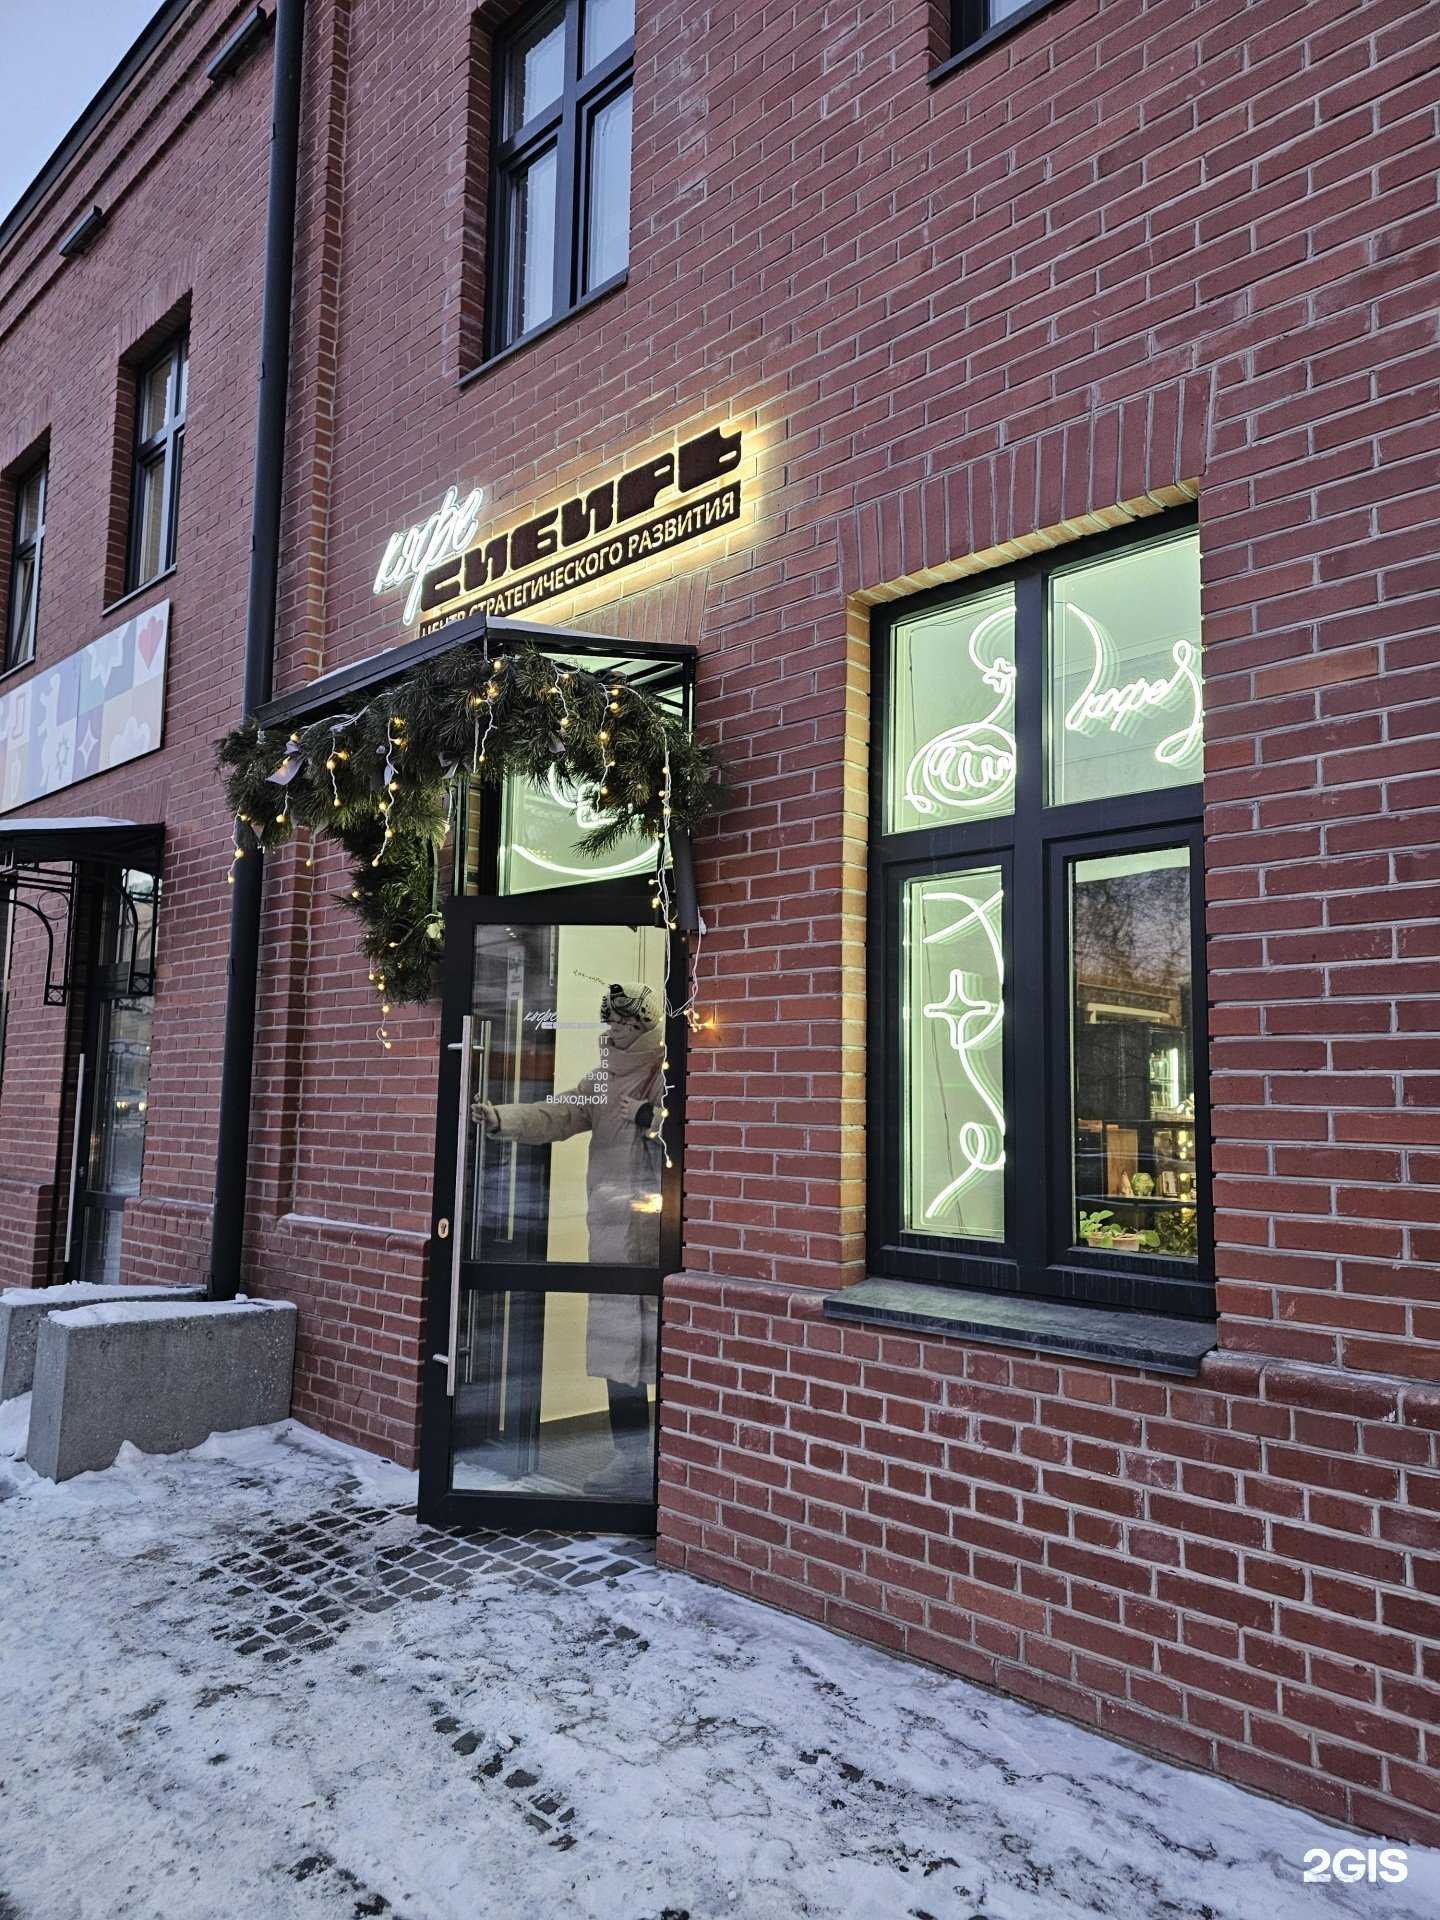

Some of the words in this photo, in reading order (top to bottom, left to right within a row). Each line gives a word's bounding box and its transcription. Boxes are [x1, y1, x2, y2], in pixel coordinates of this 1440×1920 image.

[627, 490, 735, 559] РАЗВИТИЯ
[593, 1083, 609, 1093] ВС
[546, 1094, 609, 1106] ВЫХОДНОЙ
